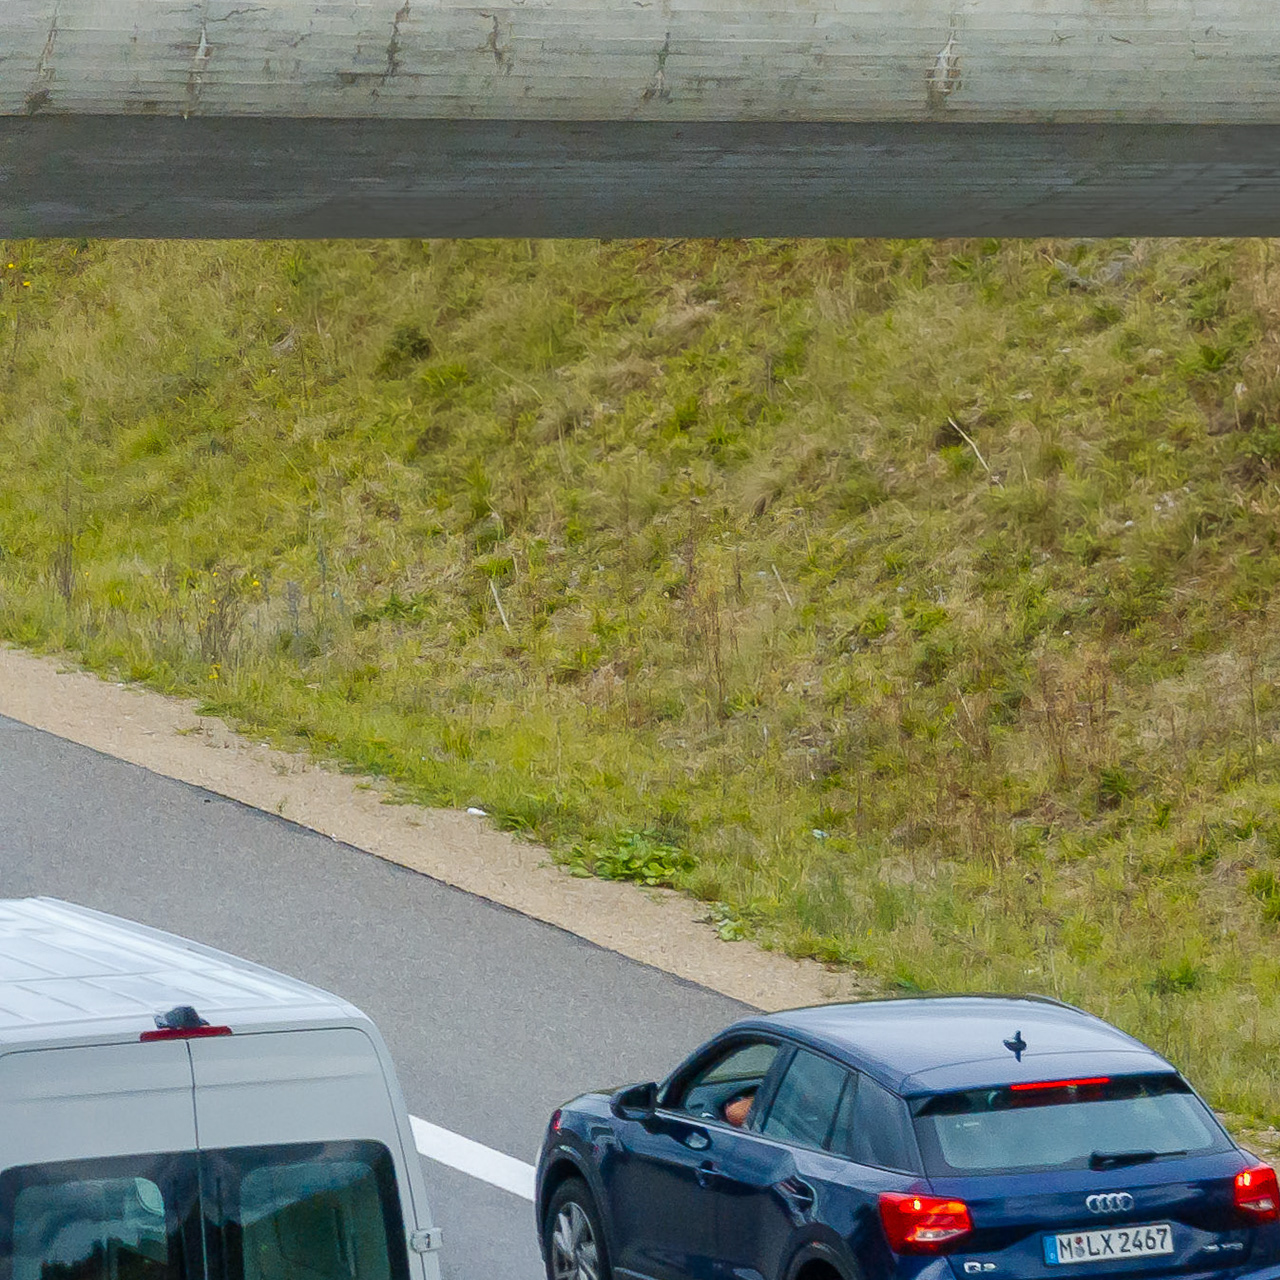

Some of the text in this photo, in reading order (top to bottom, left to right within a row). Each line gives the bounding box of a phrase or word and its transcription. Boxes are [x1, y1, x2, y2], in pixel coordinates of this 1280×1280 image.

[1058, 1237, 1073, 1259] M
[1087, 1232, 1113, 1256] LX
[1118, 1228, 1169, 1253] 2467
